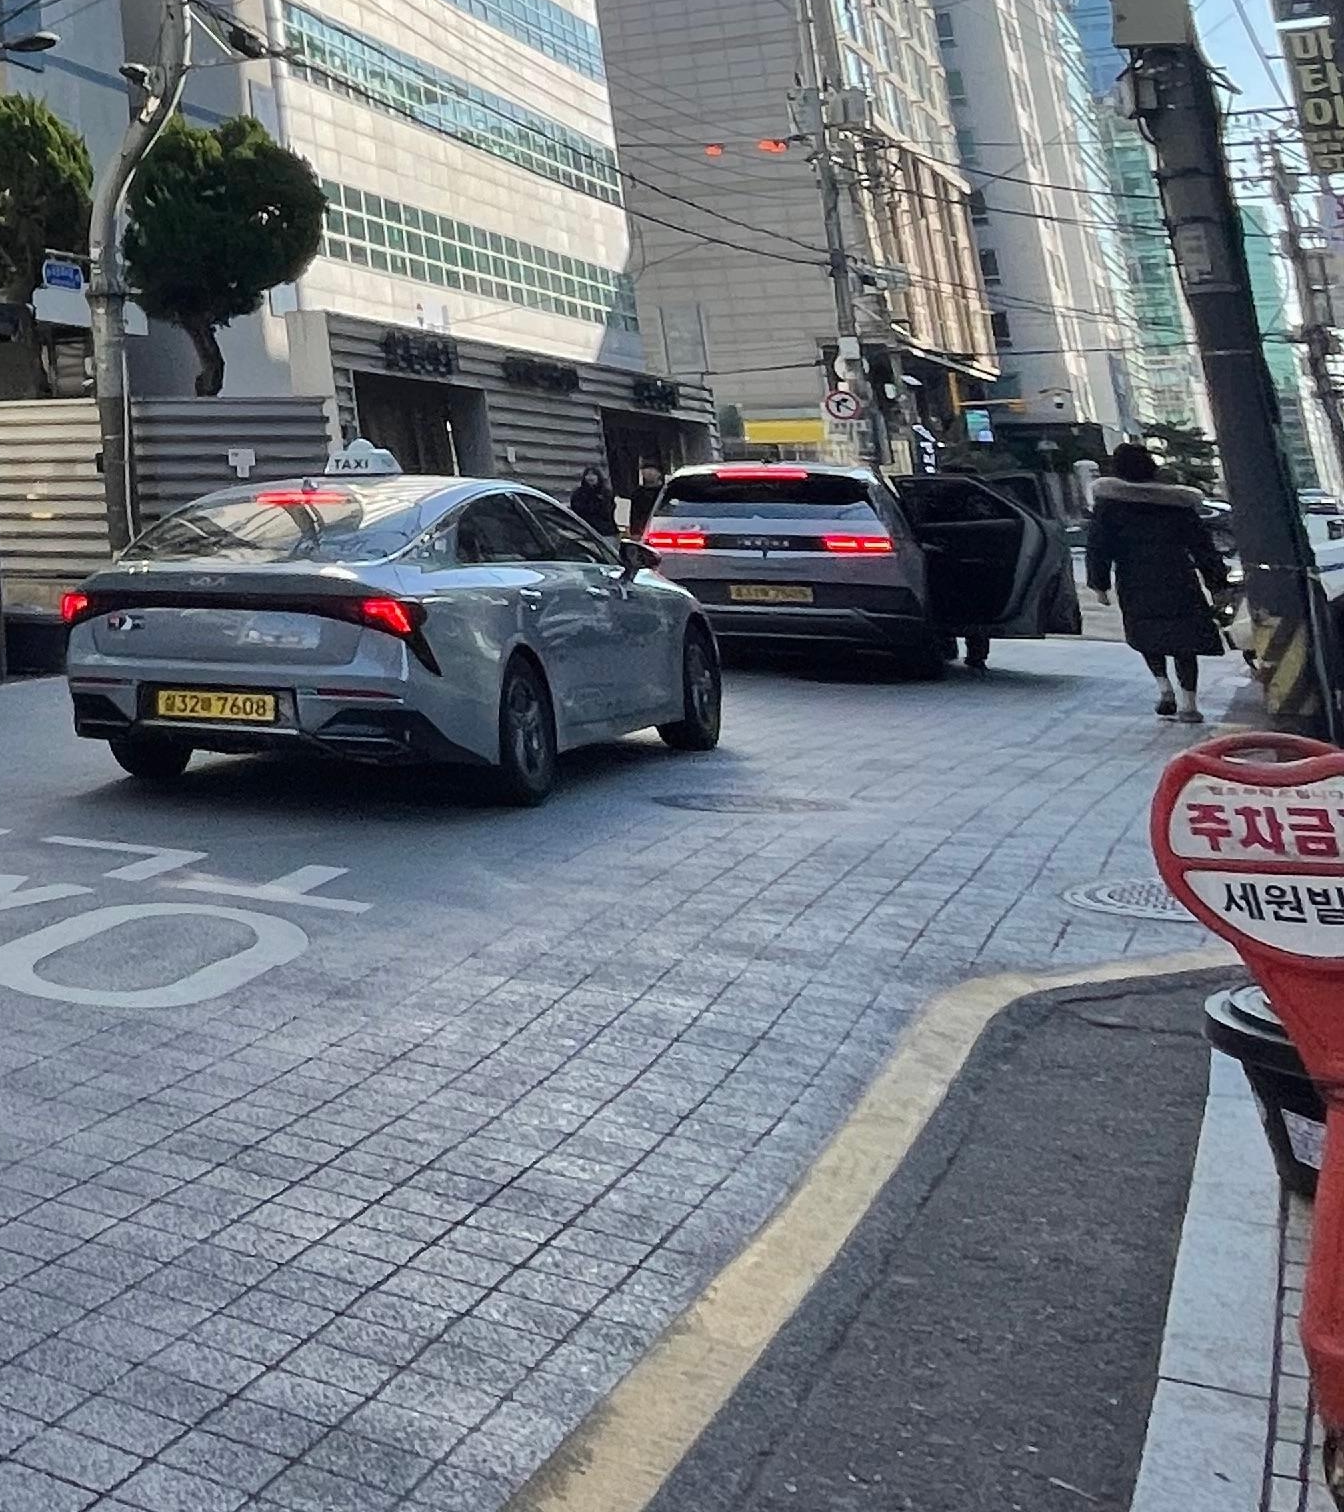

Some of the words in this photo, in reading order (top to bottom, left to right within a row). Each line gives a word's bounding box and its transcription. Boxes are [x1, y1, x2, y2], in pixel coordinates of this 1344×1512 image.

[334, 458, 369, 470] TAXI
[216, 696, 267, 716] 7608
[1185, 802, 1344, 858] 주차금
